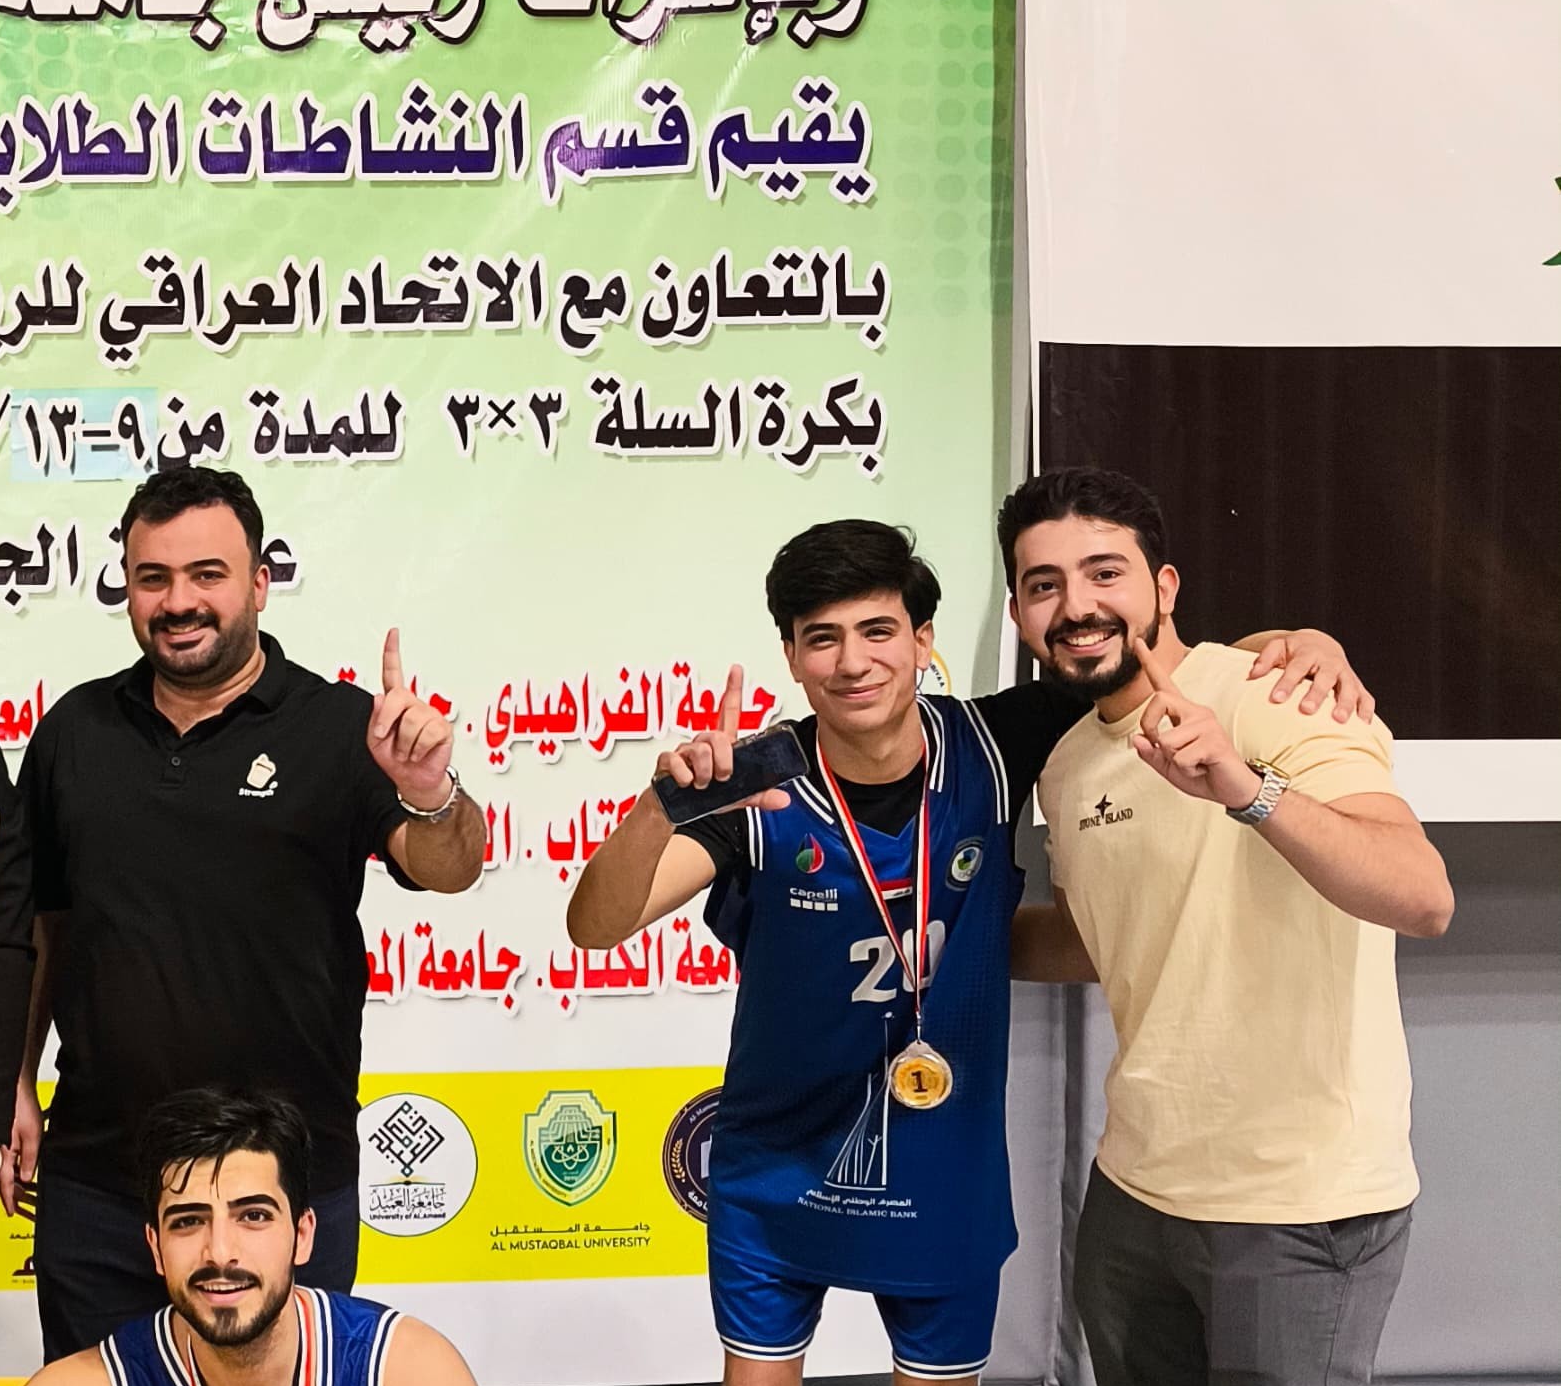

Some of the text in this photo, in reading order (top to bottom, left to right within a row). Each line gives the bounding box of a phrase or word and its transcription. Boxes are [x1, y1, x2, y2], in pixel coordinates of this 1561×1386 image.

[197, 83, 528, 179] النشاطات
[544, 83, 692, 203] قسم
[706, 80, 875, 201] يقيم
[97, 253, 322, 363] العراقي
[339, 255, 543, 327] الاتحاد
[559, 267, 629, 351] مع
[641, 249, 887, 345] بالتعاون
[156, 395, 228, 471] من
[248, 388, 403, 458] للمدة
[589, 375, 743, 455] السلة
[753, 377, 885, 475] بكرة
[485, 666, 665, 766] الفراهيدي
[1105, 807, 1134, 825] ISLAND
[790, 887, 838, 901] capelli
[416, 920, 524, 1011] جامعة
[848, 920, 947, 1003] 20
[910, 1070, 927, 1094] 1
[490, 1222, 651, 1238] جامعة المستقبل
[491, 1236, 651, 1252] AL MUSTAQBAL UNIVERSITY
[797, 1196, 918, 1219] NATIONAL ISLAMIC BANK
